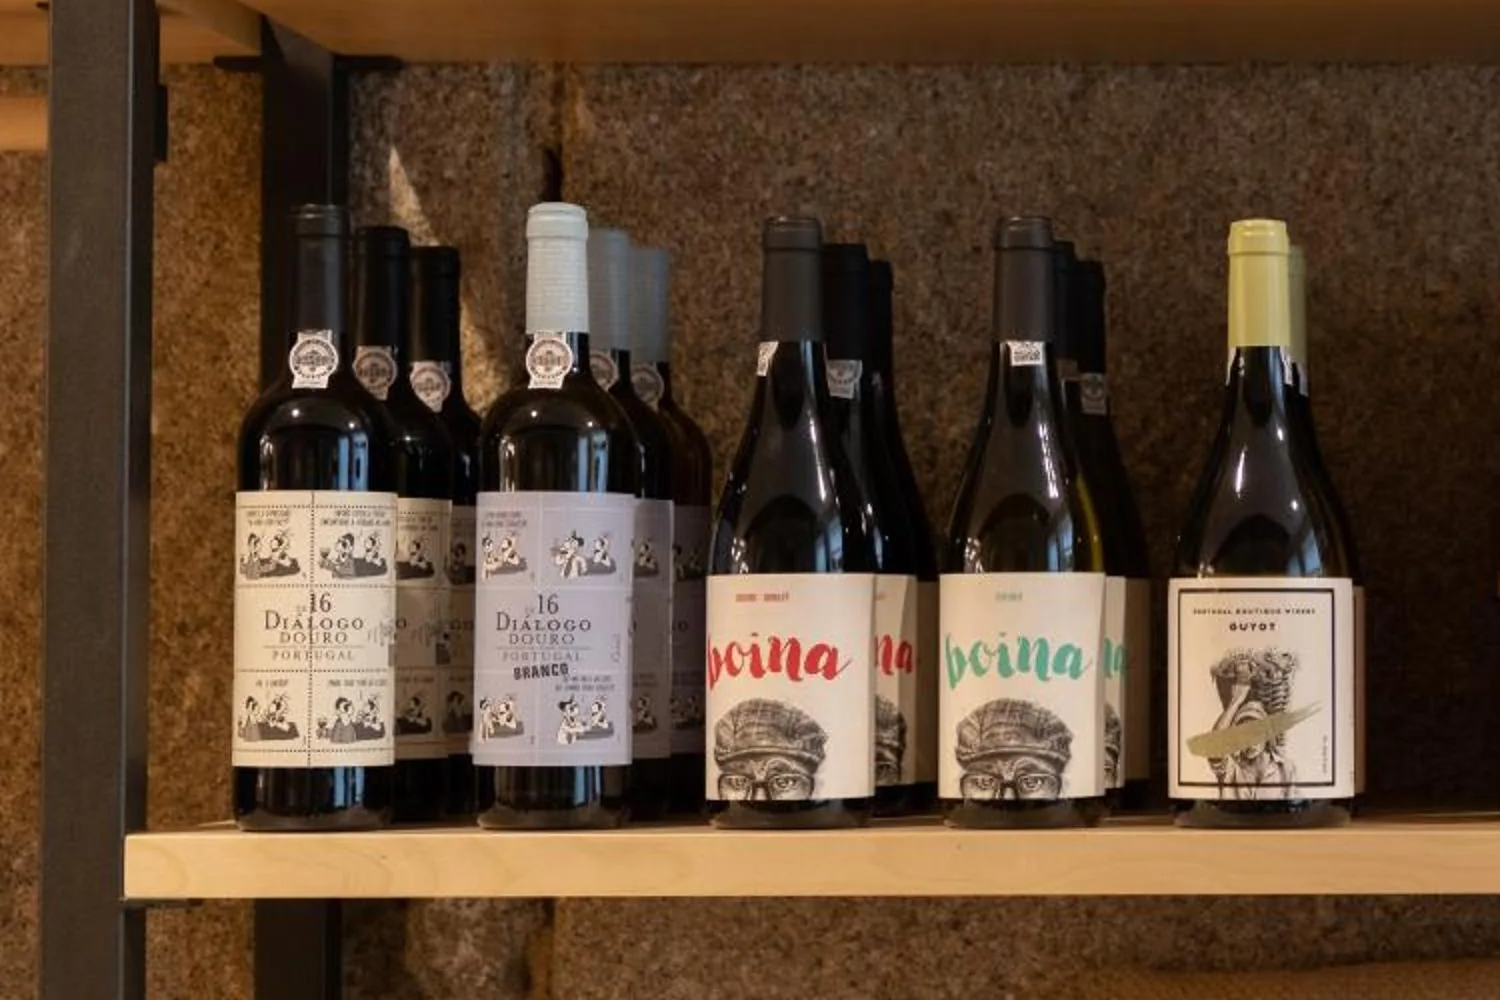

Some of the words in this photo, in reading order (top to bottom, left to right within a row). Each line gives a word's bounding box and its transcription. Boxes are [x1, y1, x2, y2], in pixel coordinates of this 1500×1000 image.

[537, 593, 559, 615] 16
[279, 631, 348, 644] DOURO
[509, 633, 575, 645] DOURO
[272, 651, 356, 661] PORTUGAL
[502, 651, 581, 662] PORTUGAL
[945, 631, 1092, 690] boina
[513, 662, 570, 681] BRANCO
